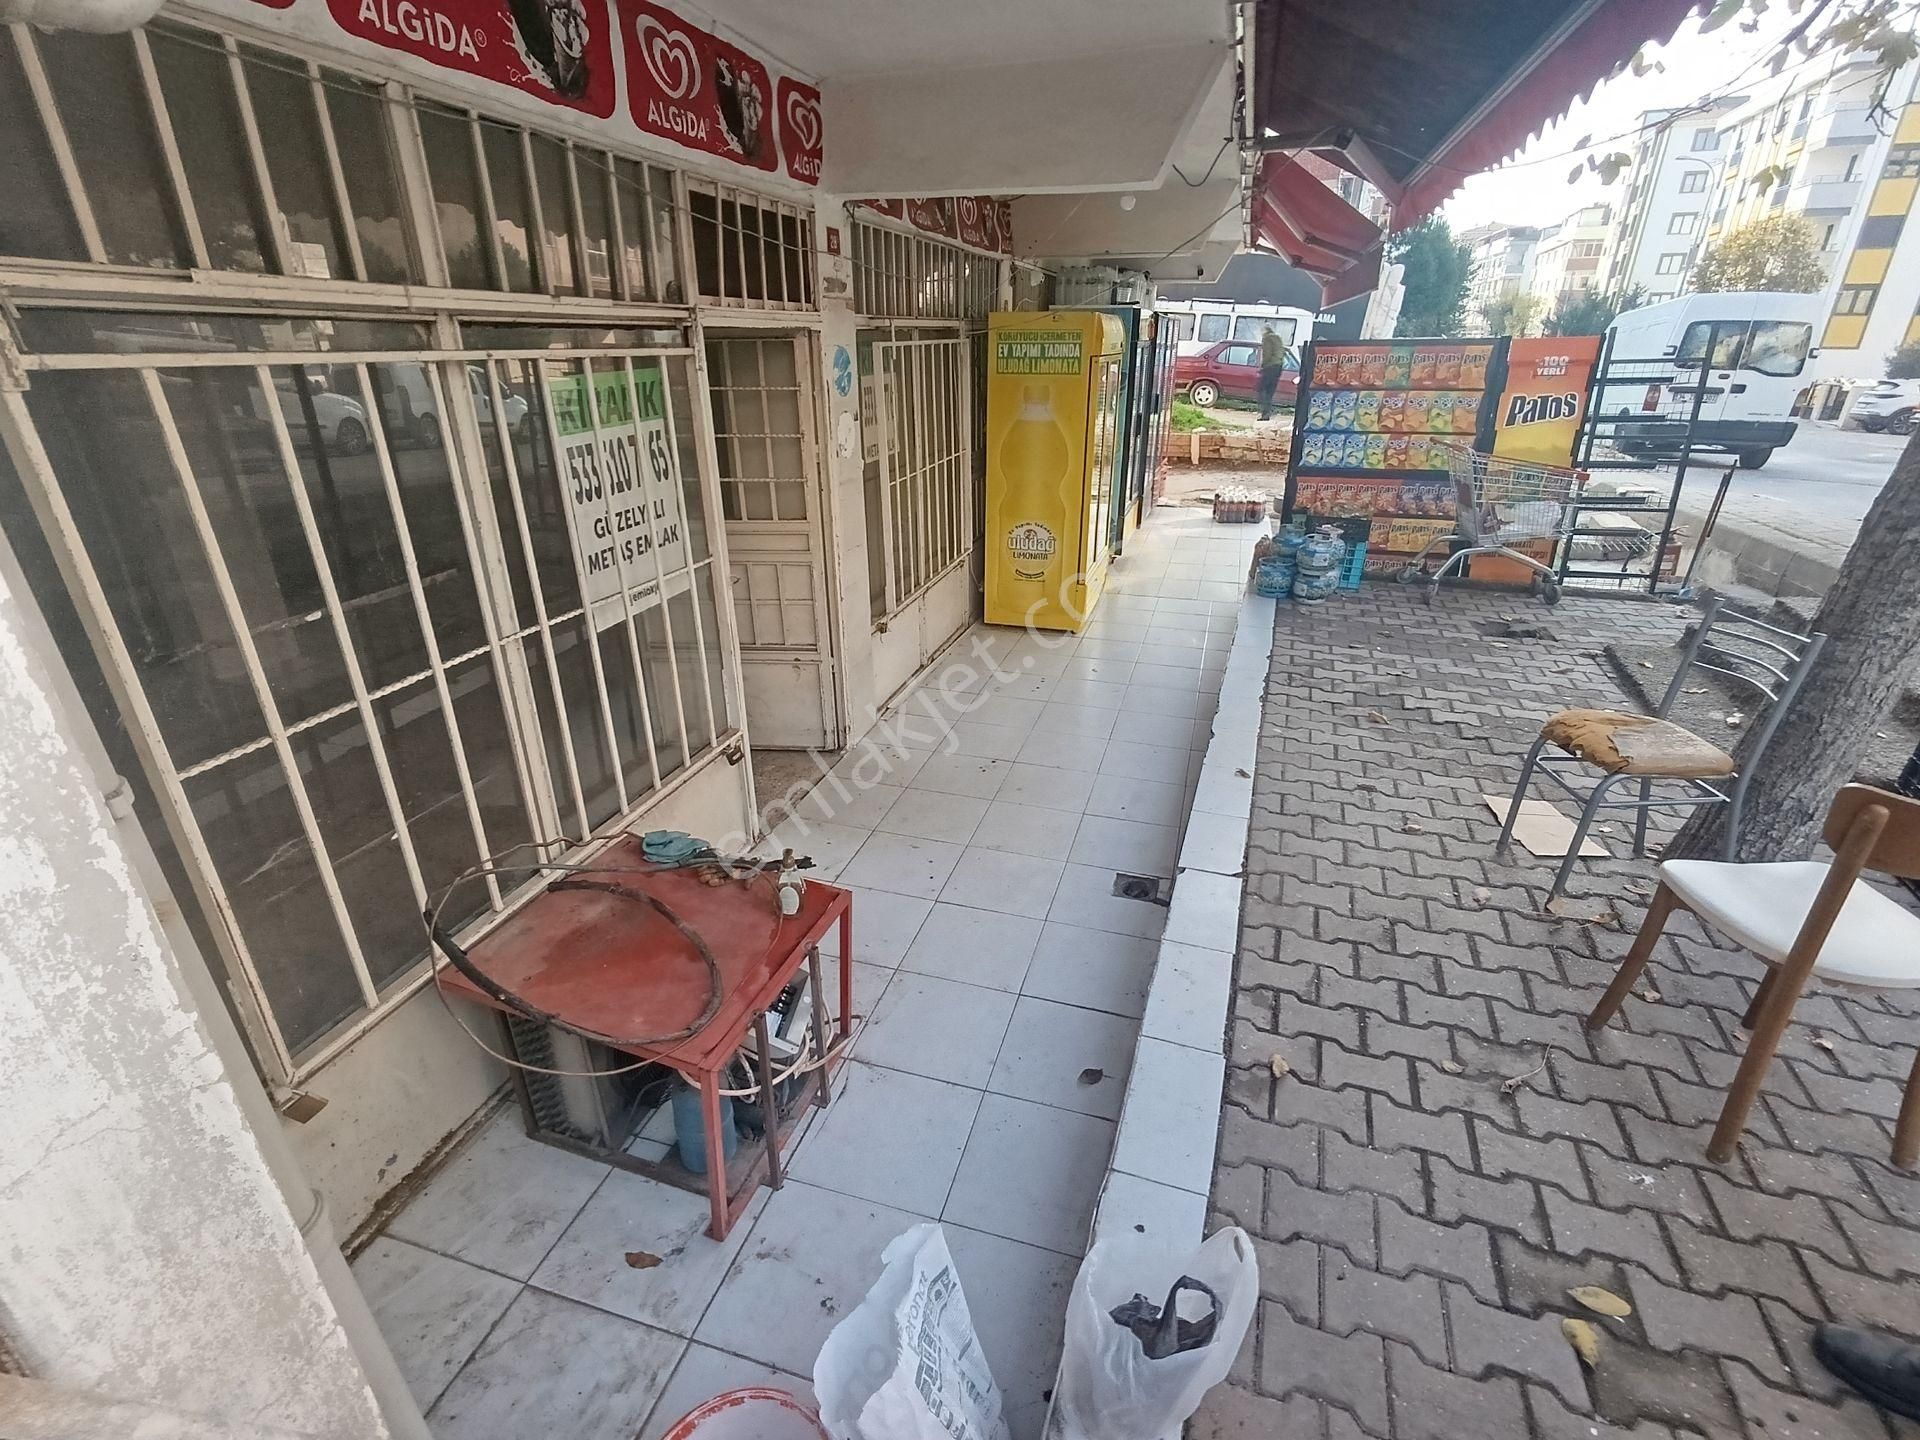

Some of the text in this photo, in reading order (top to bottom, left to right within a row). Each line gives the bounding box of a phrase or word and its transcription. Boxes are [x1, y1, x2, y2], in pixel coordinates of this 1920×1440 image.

[998, 344, 1081, 358] EV YAPIMI TADINDA
